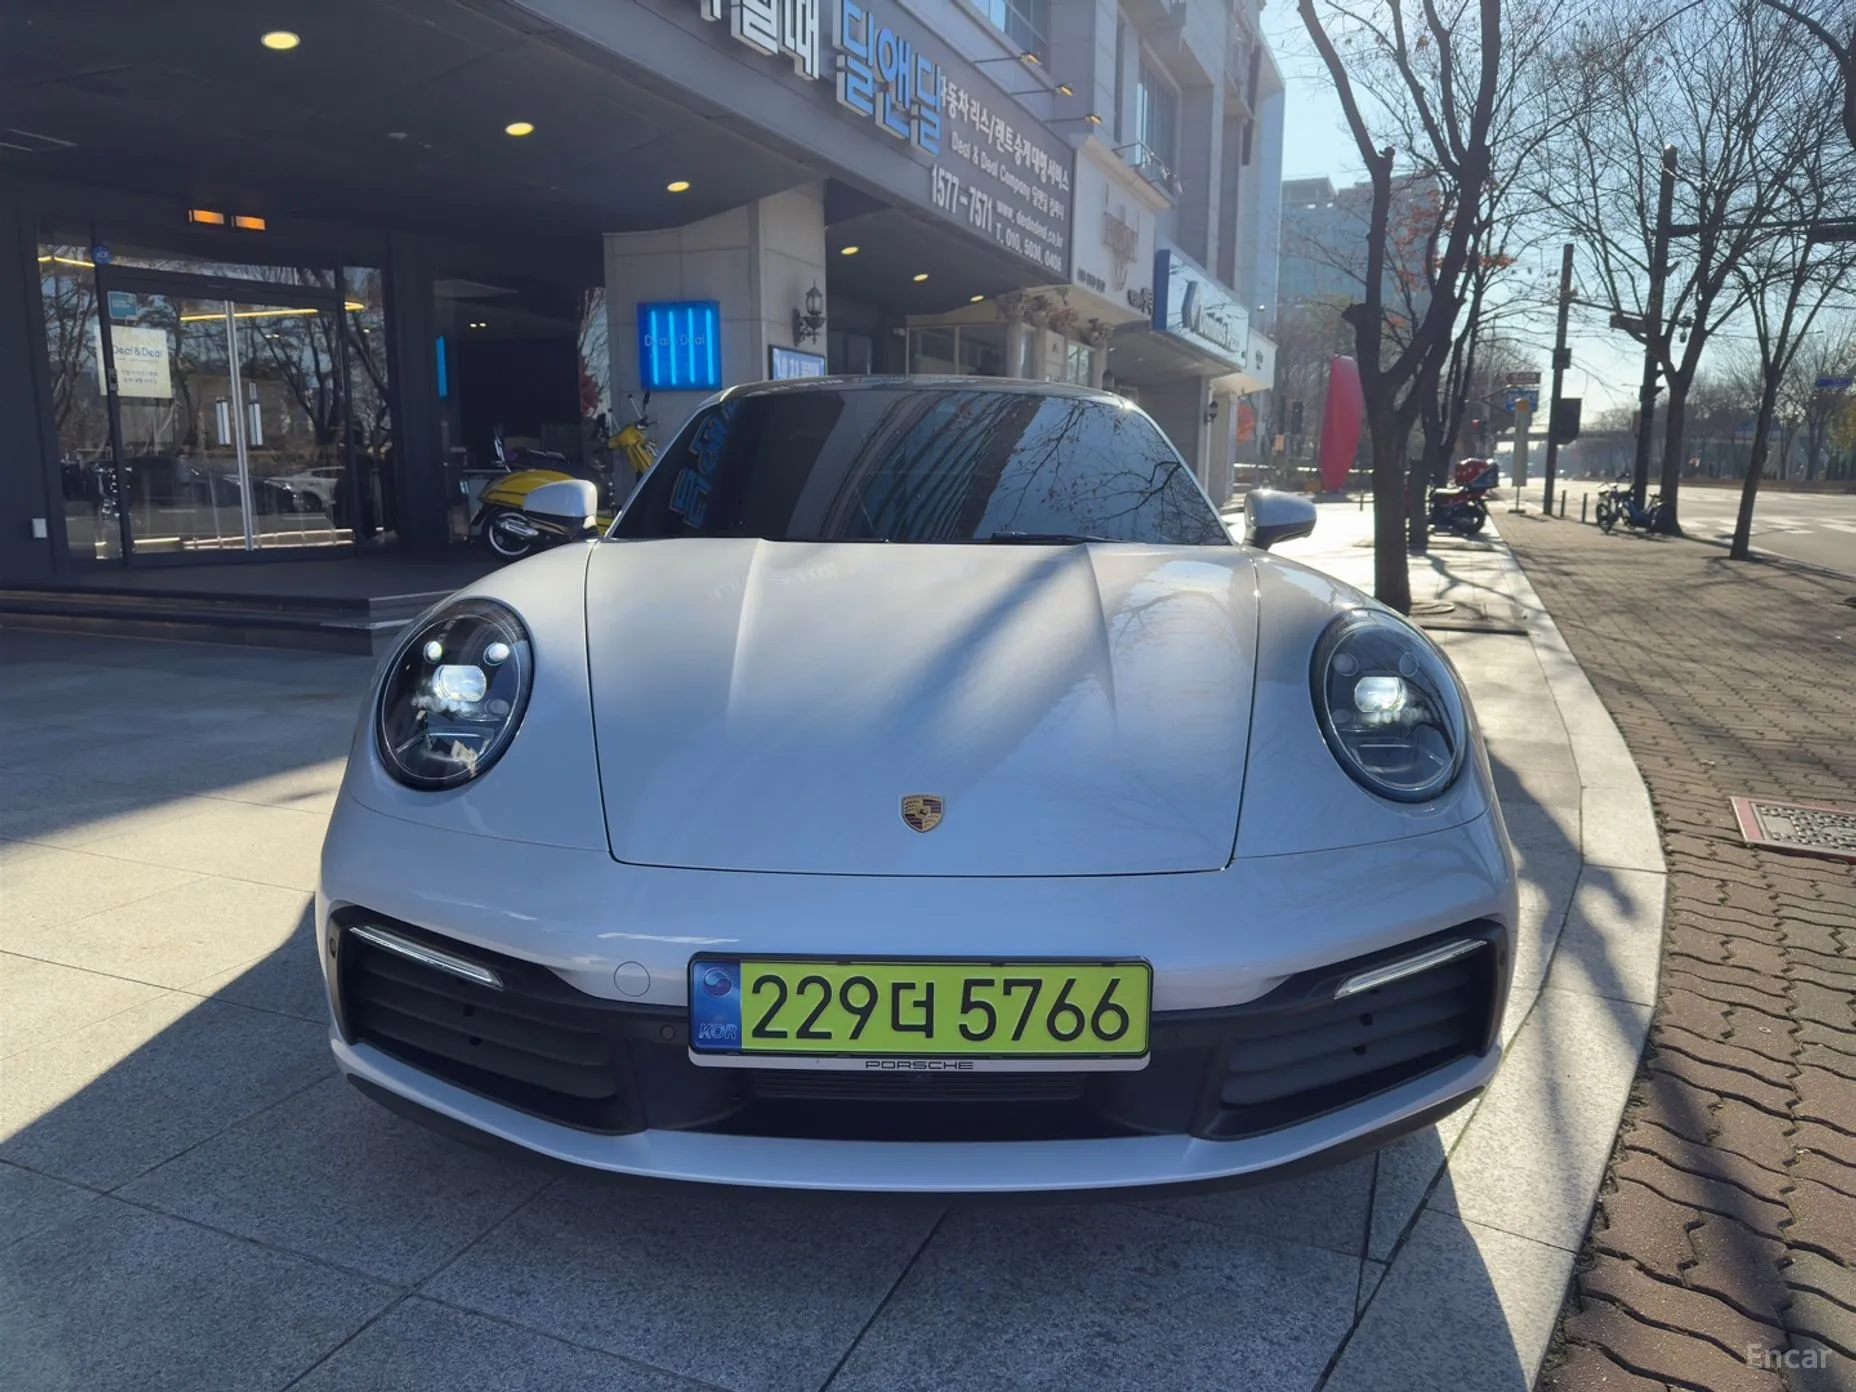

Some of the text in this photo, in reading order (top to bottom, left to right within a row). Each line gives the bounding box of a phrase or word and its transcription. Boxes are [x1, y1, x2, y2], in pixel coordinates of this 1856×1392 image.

[834, 0, 941, 157] 딜앤딜
[951, 130, 971, 160] Deal
[980, 150, 999, 177] Deal
[752, 974, 1130, 1042] 229더 5766
[699, 1023, 738, 1041] KOR
[865, 1060, 974, 1070] PORSCHE
